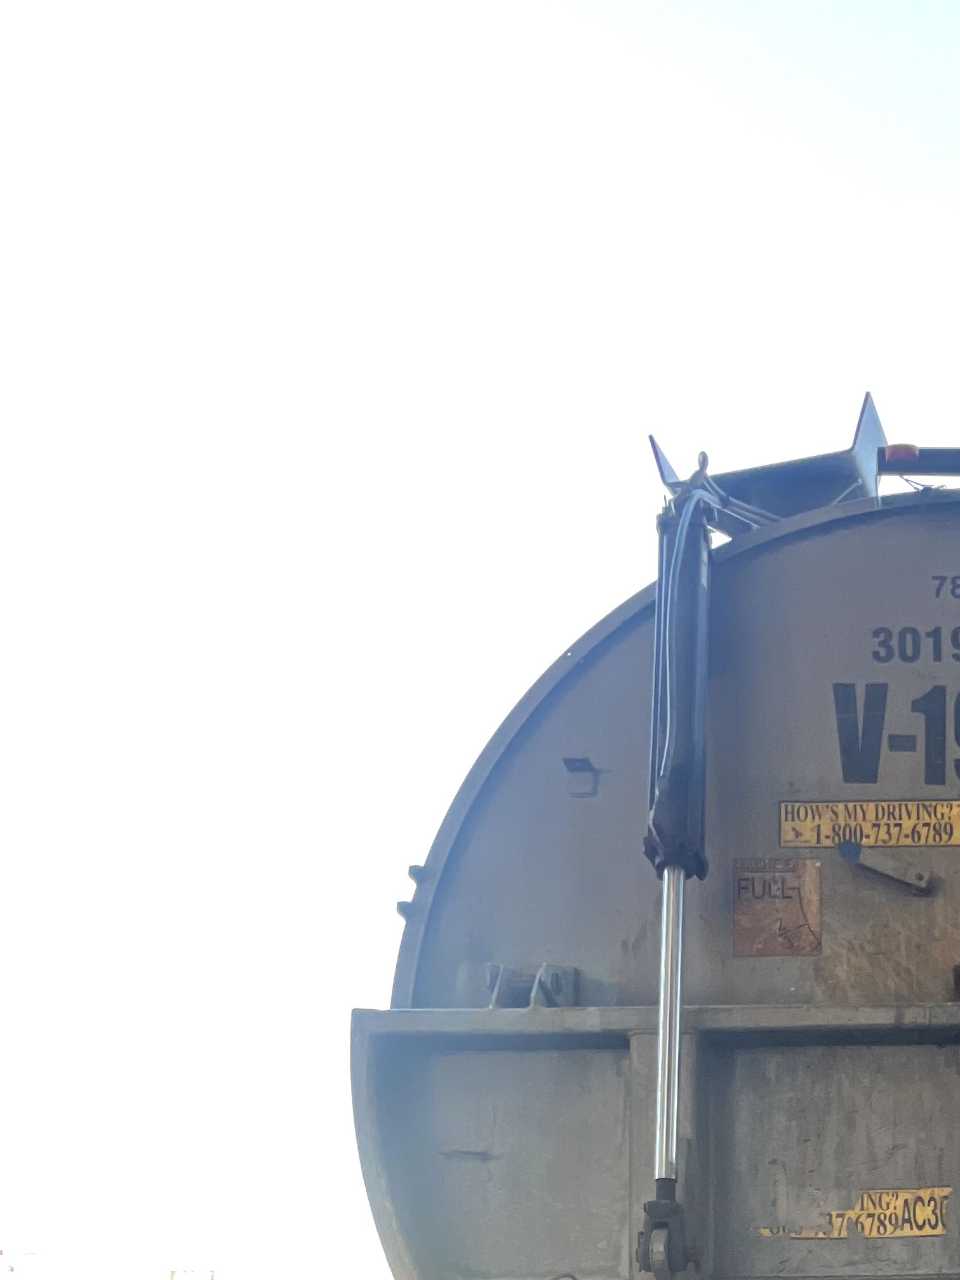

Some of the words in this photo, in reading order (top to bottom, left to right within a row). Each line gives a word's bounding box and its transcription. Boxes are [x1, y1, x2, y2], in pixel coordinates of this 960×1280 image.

[784, 803, 839, 822] HOW'S
[844, 803, 869, 821] MY
[875, 802, 953, 821] DRIVING?
[815, 821, 954, 845] 1-800-737-6789
